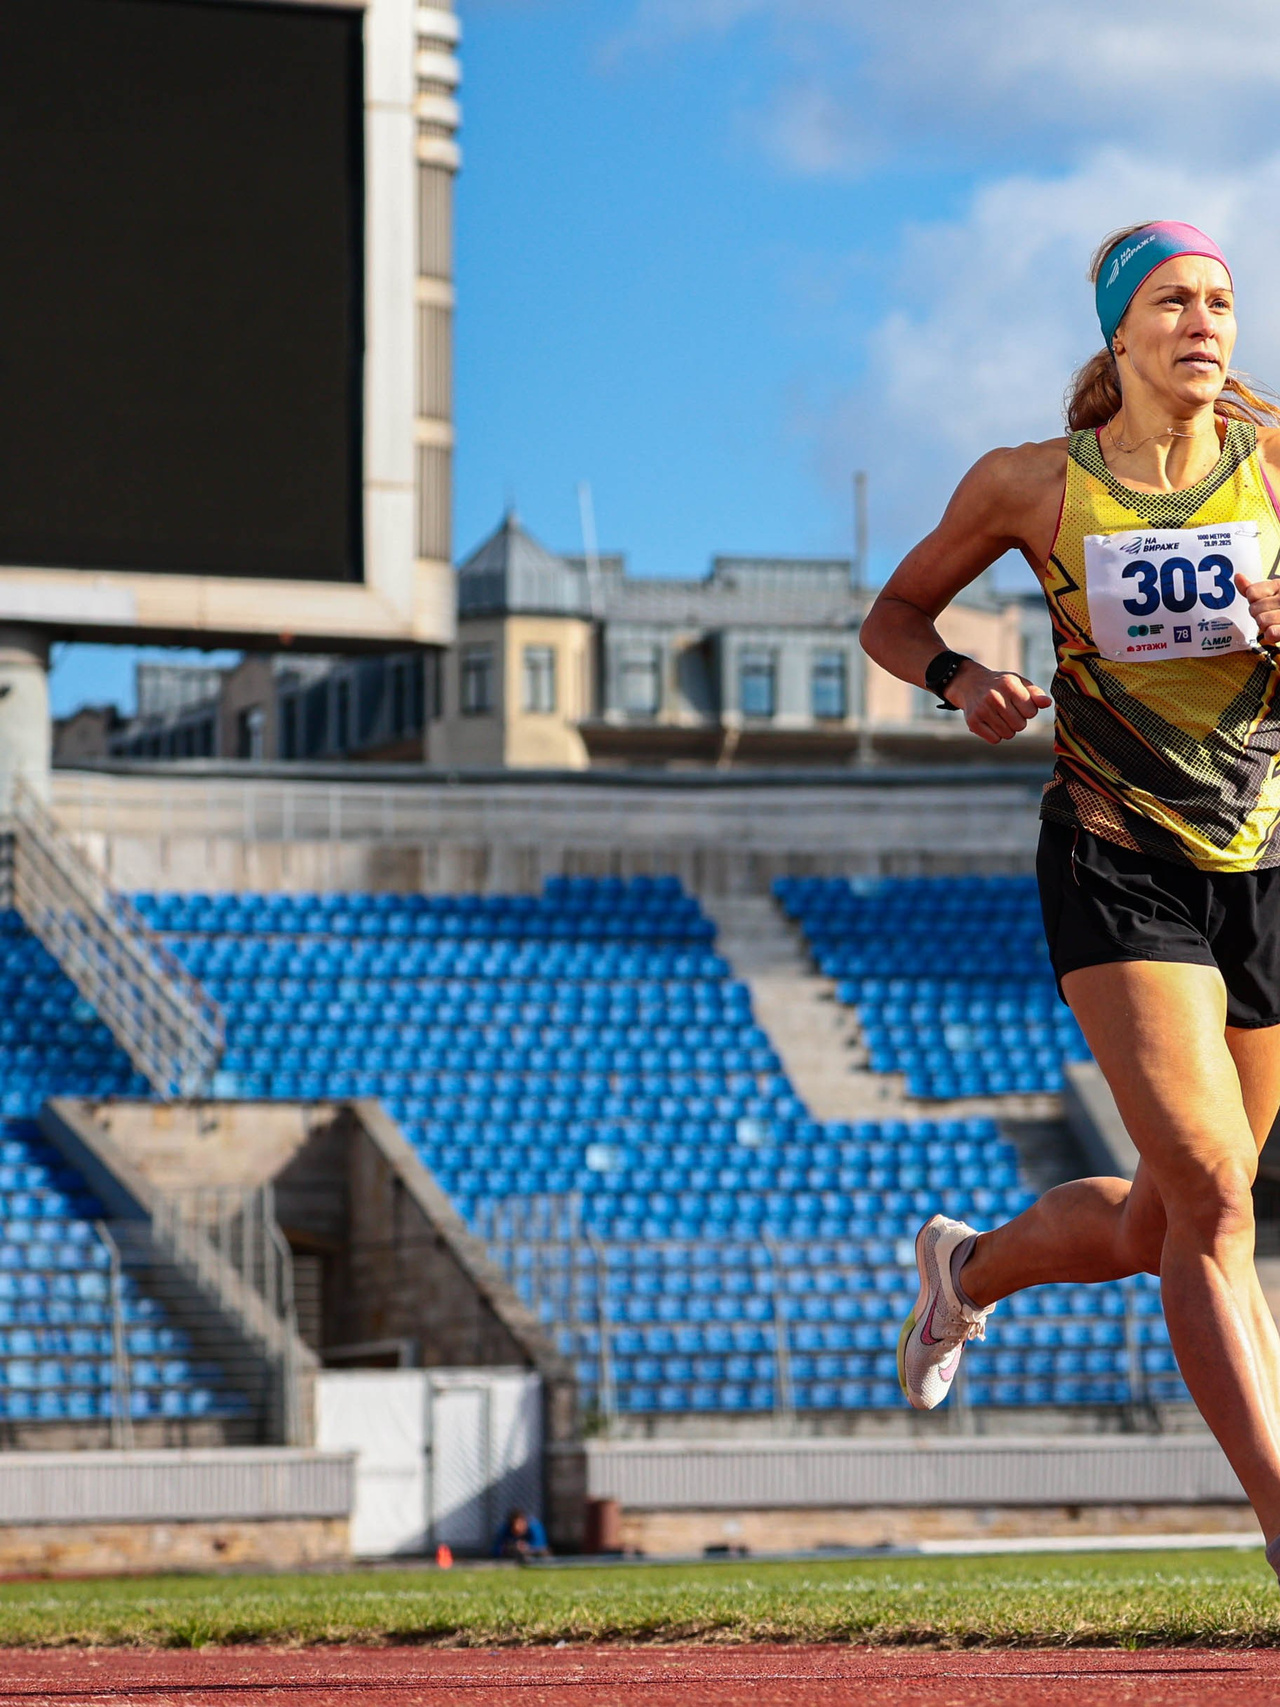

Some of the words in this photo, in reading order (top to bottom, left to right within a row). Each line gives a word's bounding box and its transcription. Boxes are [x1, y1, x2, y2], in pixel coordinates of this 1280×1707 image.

[1120, 247, 1131, 260] НА
[1143, 542, 1179, 552] ВИРАЖЕ
[1122, 554, 1236, 616] 303
[1176, 629, 1189, 640] 78
